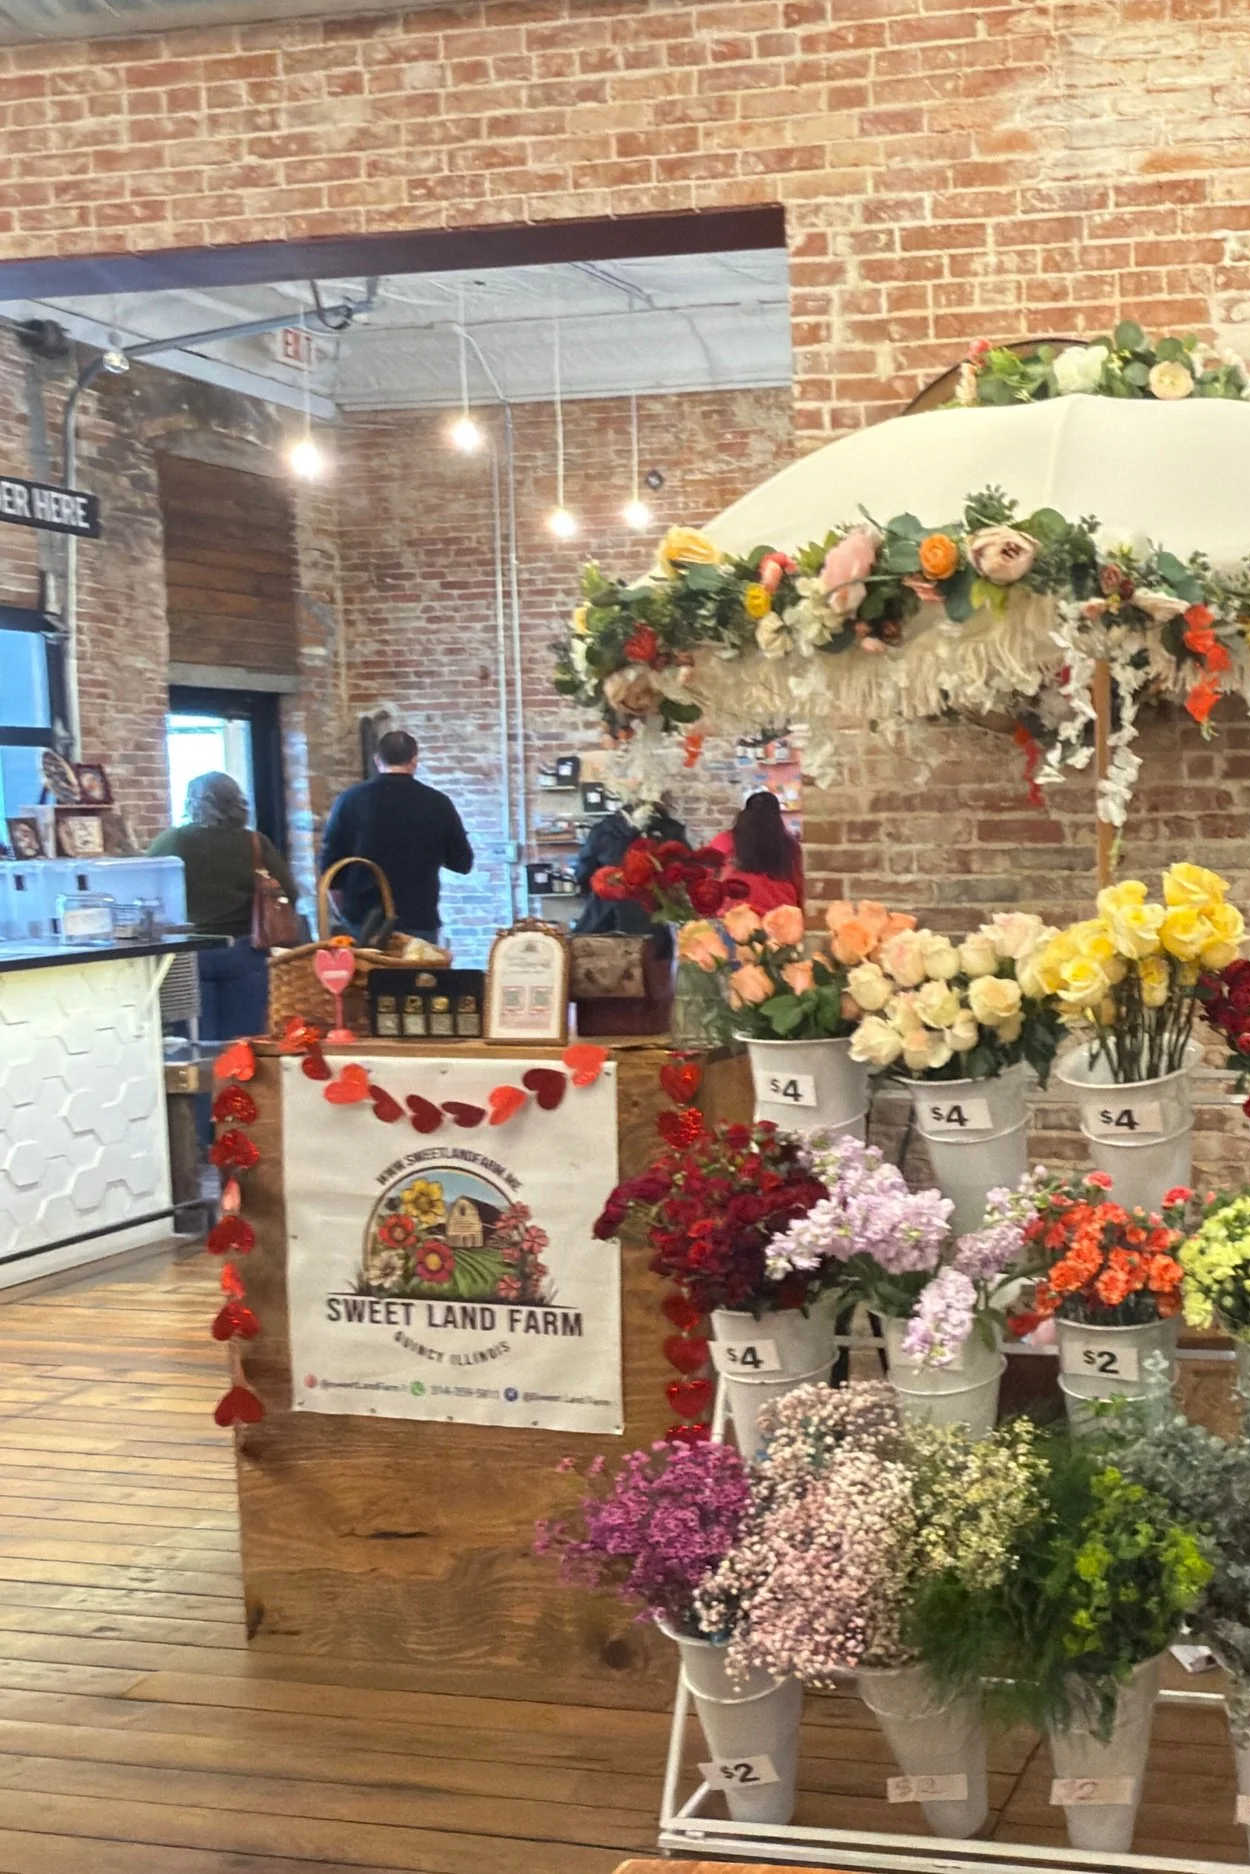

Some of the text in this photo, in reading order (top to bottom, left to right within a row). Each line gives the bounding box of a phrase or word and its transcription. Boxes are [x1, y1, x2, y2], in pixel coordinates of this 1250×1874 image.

[31, 487, 90, 528] HERE
[770, 1078, 803, 1102] $4
[931, 1105, 969, 1127] $4
[1100, 1109, 1139, 1130] $4
[327, 1298, 584, 1337] SWEET LAND FARM
[726, 1346, 764, 1369] $4
[1082, 1350, 1119, 1374] $2
[720, 1762, 761, 1784] $2
